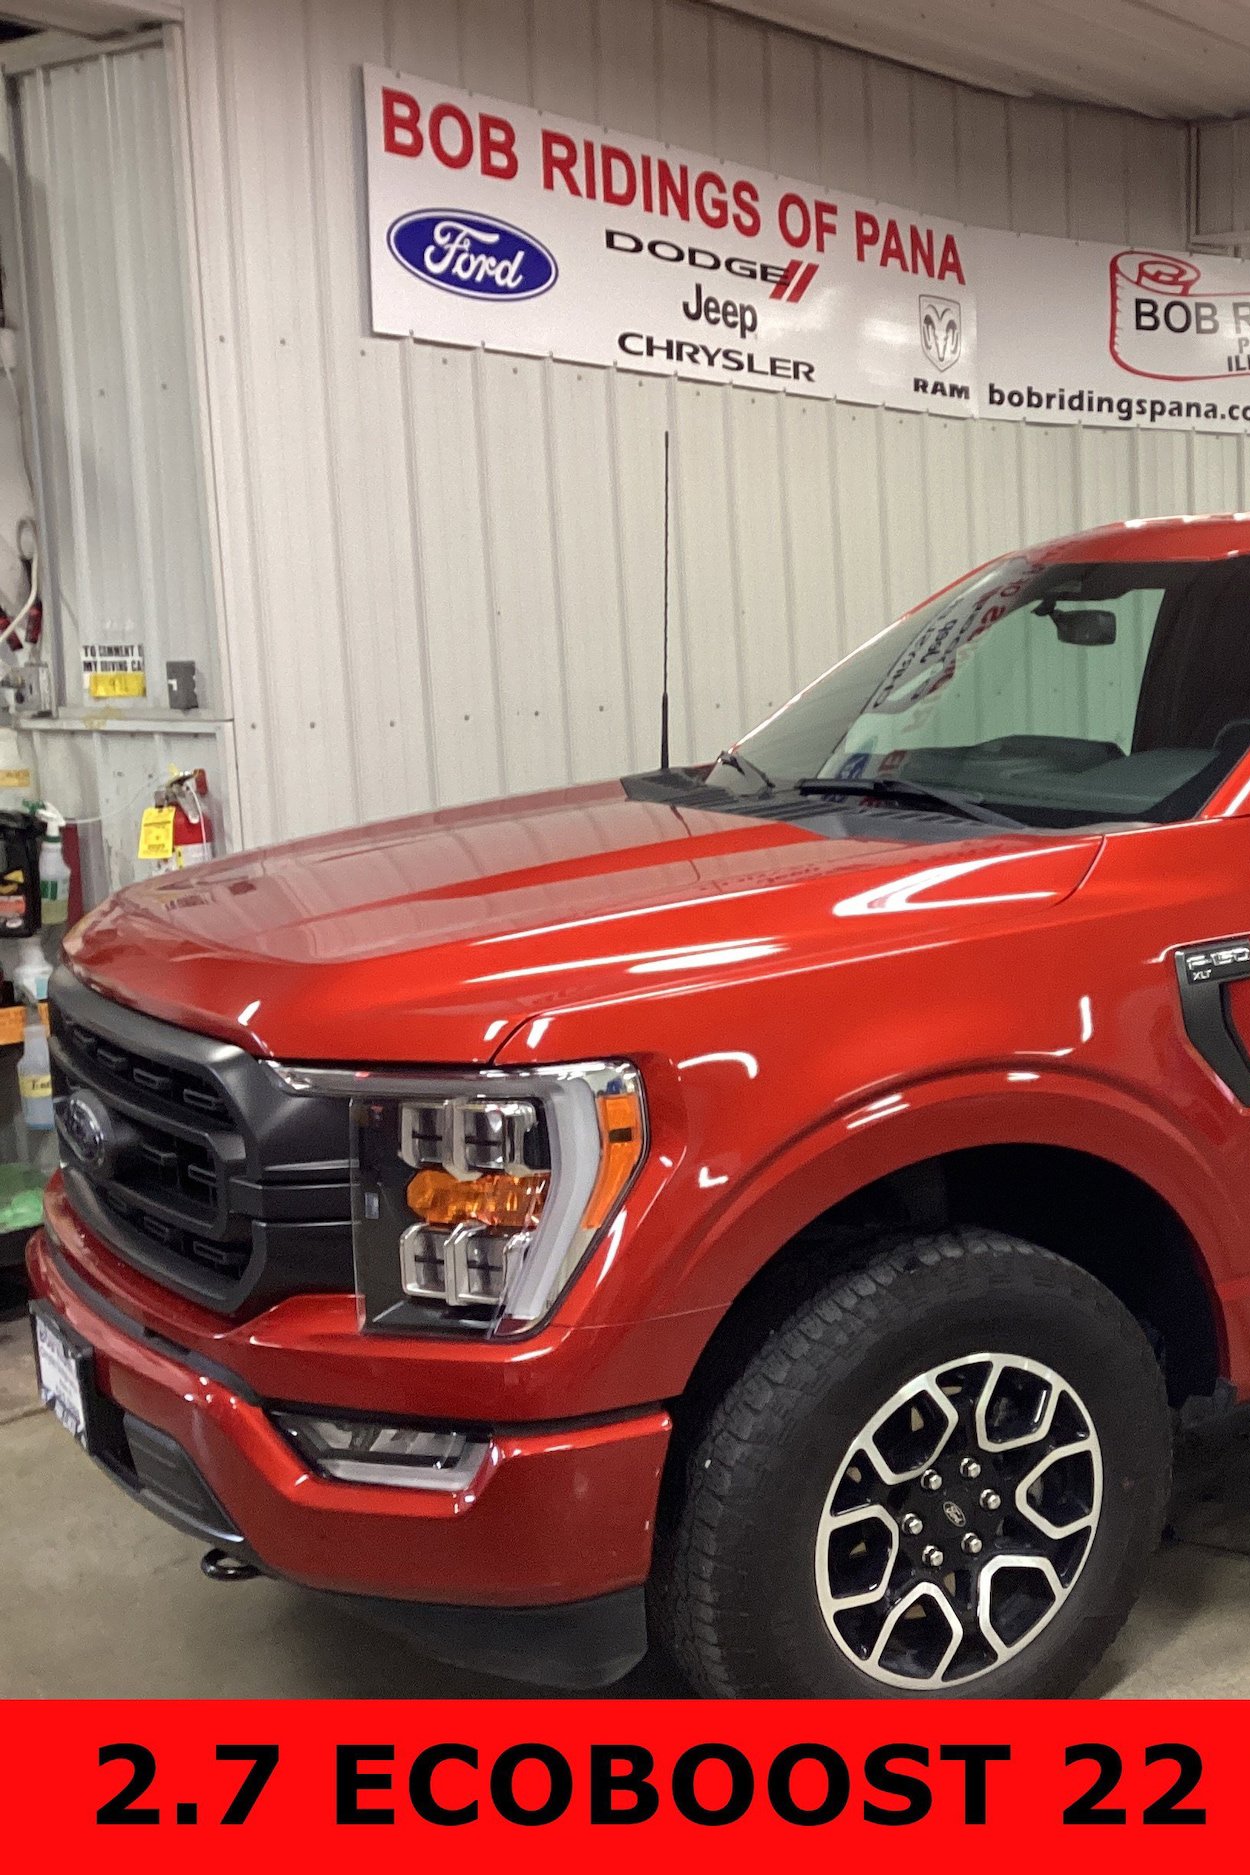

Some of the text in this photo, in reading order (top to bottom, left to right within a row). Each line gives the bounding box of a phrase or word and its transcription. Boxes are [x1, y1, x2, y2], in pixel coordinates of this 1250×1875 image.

[381, 87, 966, 285] BOB RIDINGS OF PANA
[422, 221, 524, 290] Ford
[605, 229, 789, 285] DODGE
[682, 282, 758, 339] Jeep
[1134, 297, 1219, 335] BOB
[617, 331, 815, 383] CHRYSLER
[914, 377, 970, 400] RAM
[1193, 969, 1212, 981] XLT
